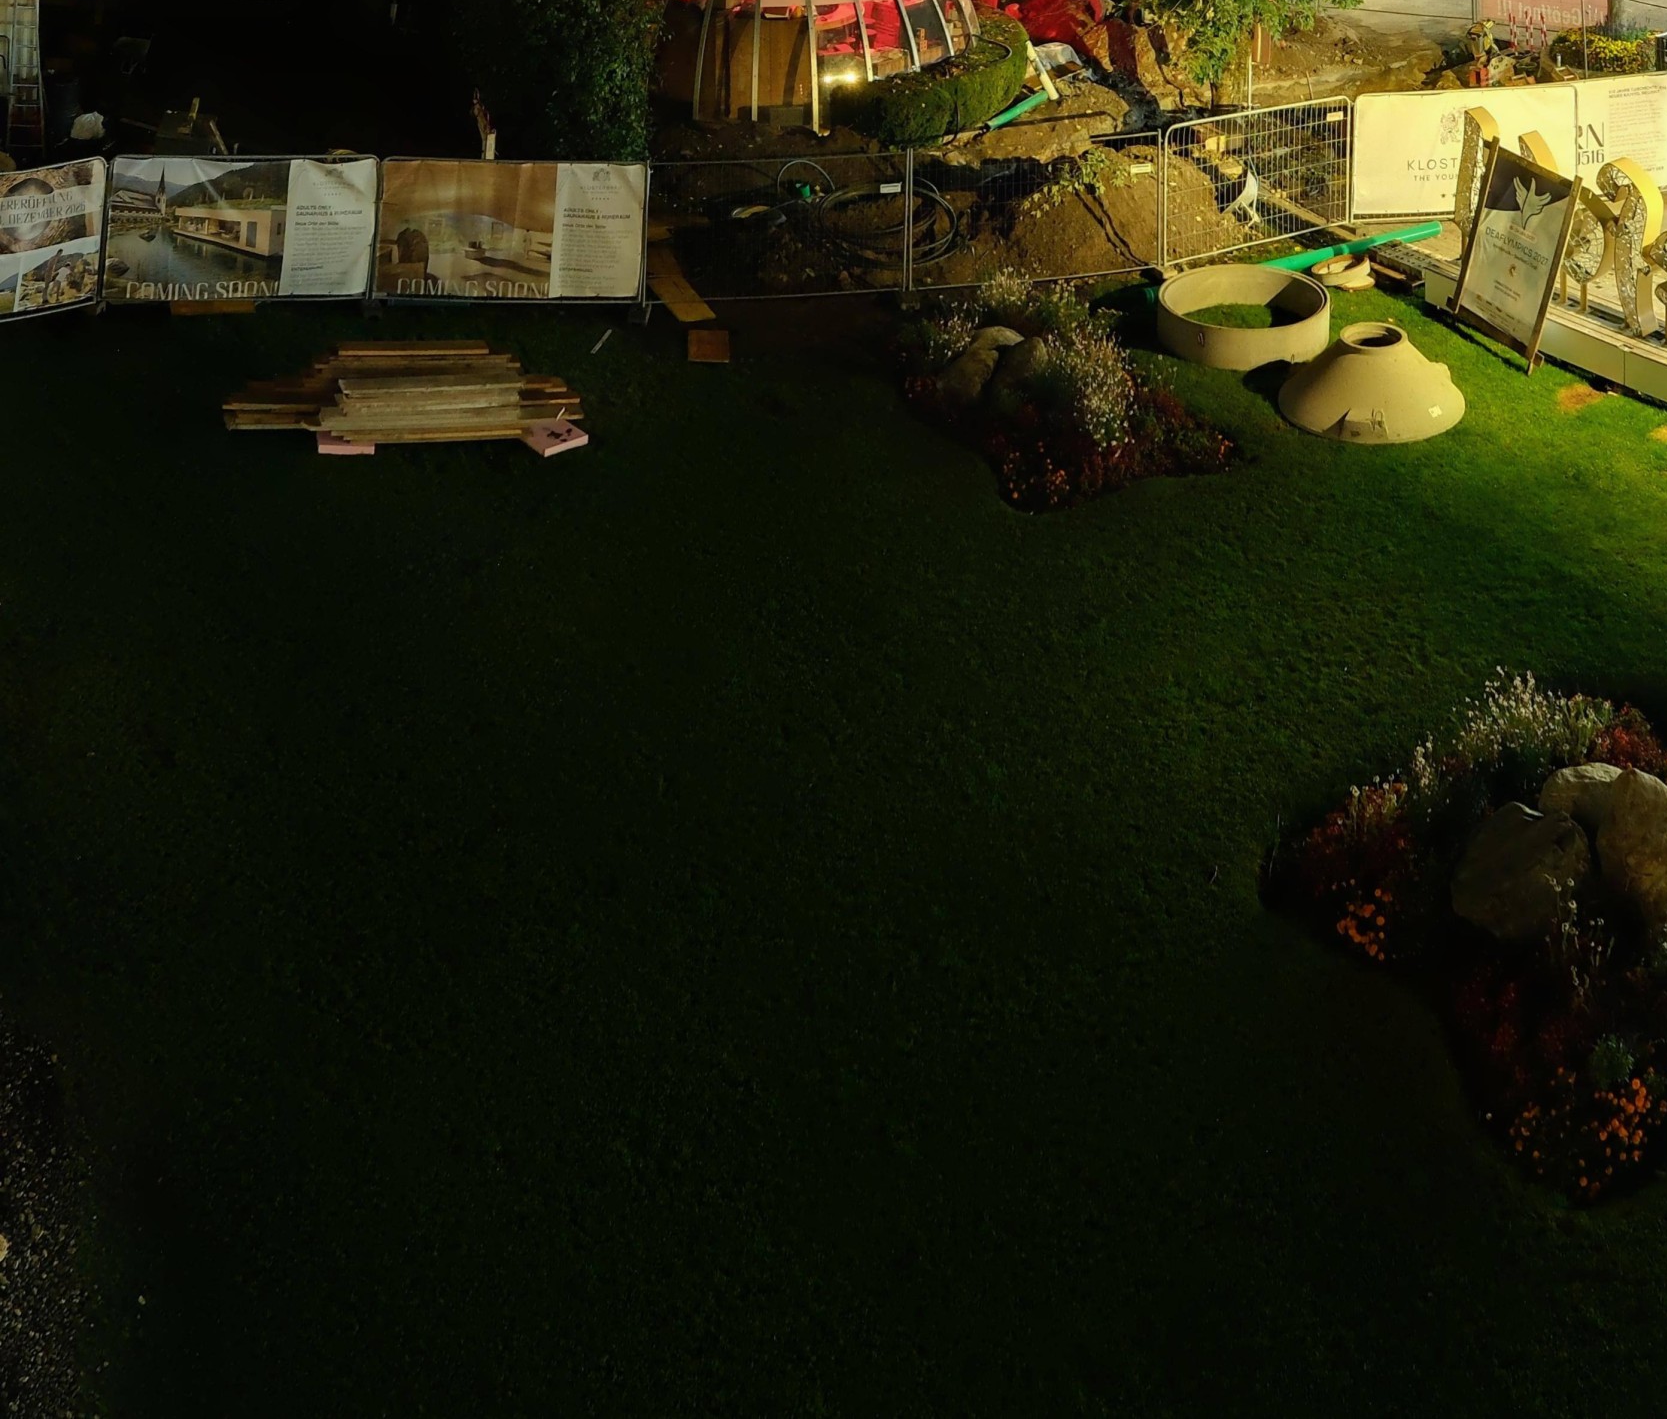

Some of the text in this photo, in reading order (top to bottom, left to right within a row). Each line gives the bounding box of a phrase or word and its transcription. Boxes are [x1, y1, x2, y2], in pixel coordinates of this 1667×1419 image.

[1414, 174, 1430, 182] THE
[1485, 226, 1533, 259] DEAFLYMPICS
[1533, 250, 1549, 266] 2027
[126, 281, 208, 300] COMING
[397, 277, 478, 298] COMING
